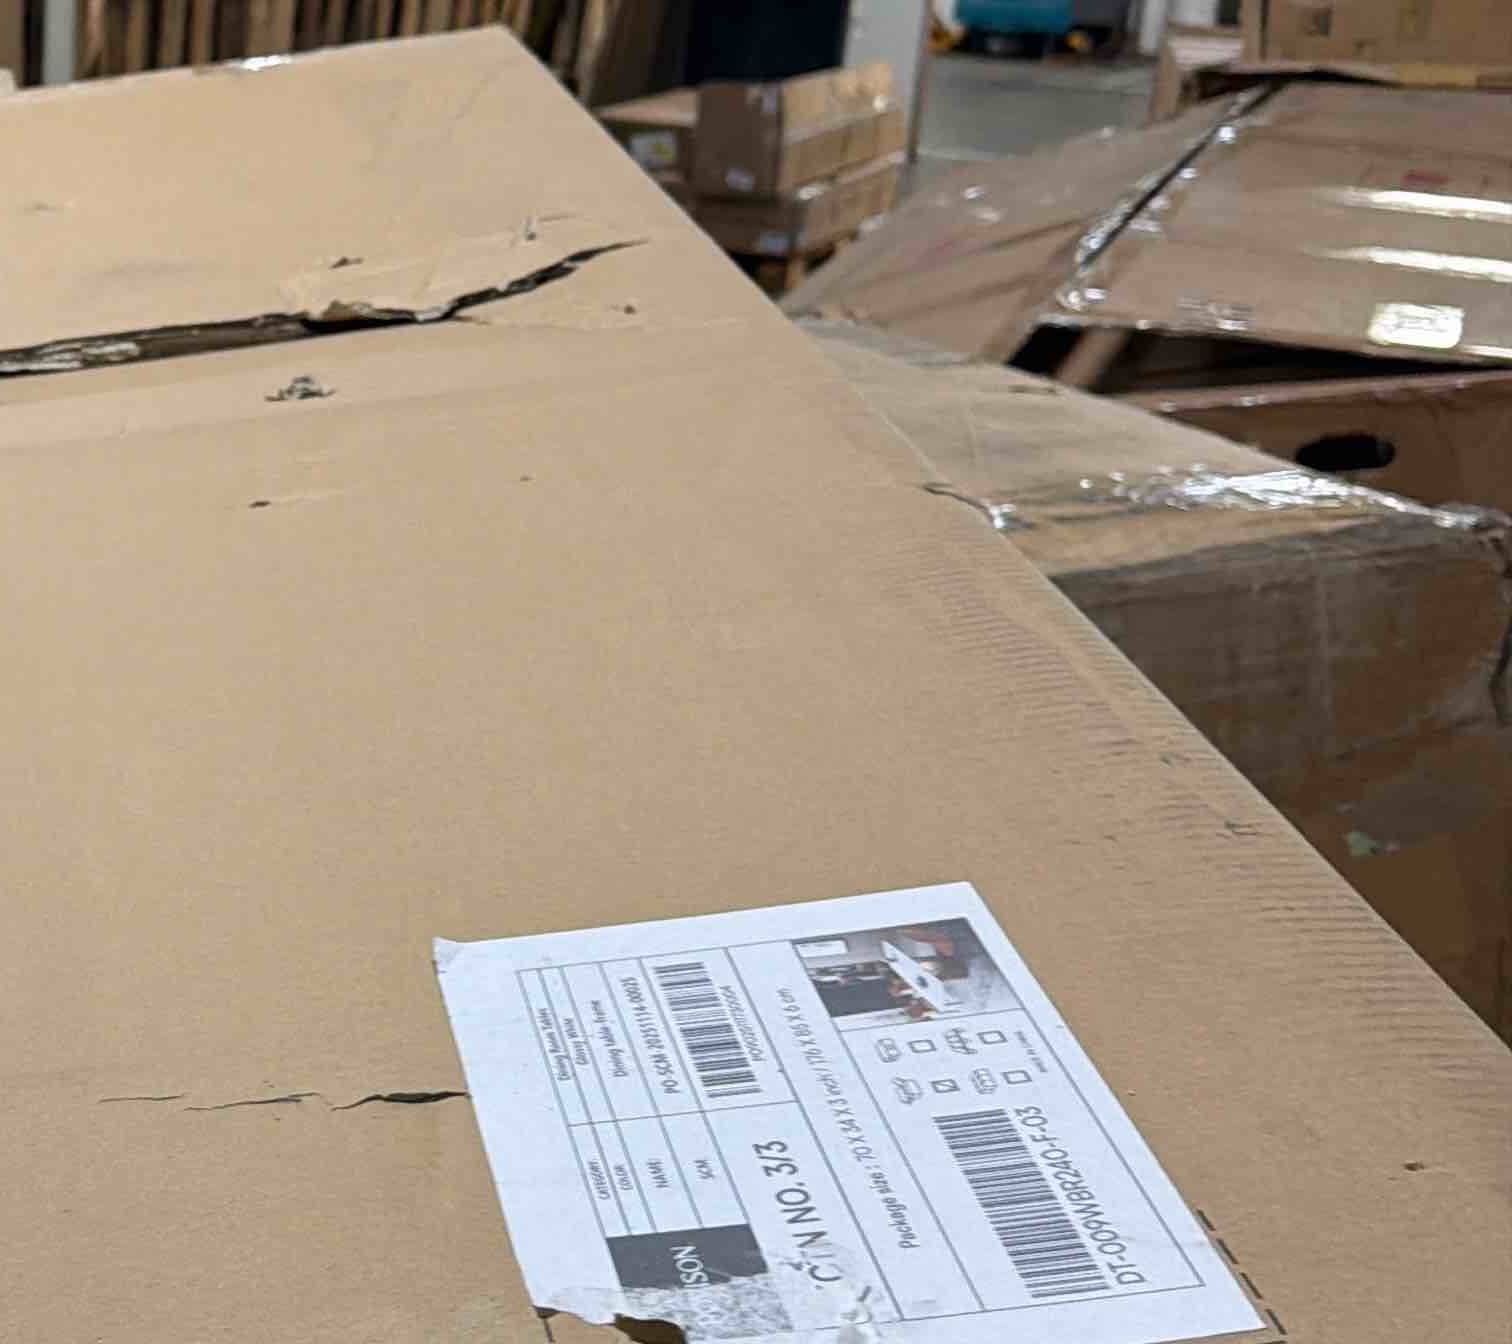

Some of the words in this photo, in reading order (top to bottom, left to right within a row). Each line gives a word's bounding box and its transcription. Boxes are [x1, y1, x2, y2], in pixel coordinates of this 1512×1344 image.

[608, 1048, 629, 1077] Dining
[837, 1118, 861, 1132] 34
[752, 1140, 798, 1177] 3/3
[851, 1146, 876, 1162] 70
[870, 1172, 893, 1194] size
[1015, 1106, 1145, 1284] DT-009WBR240-F-03
[775, 1182, 821, 1224] NO.
[882, 1197, 920, 1248] Package
